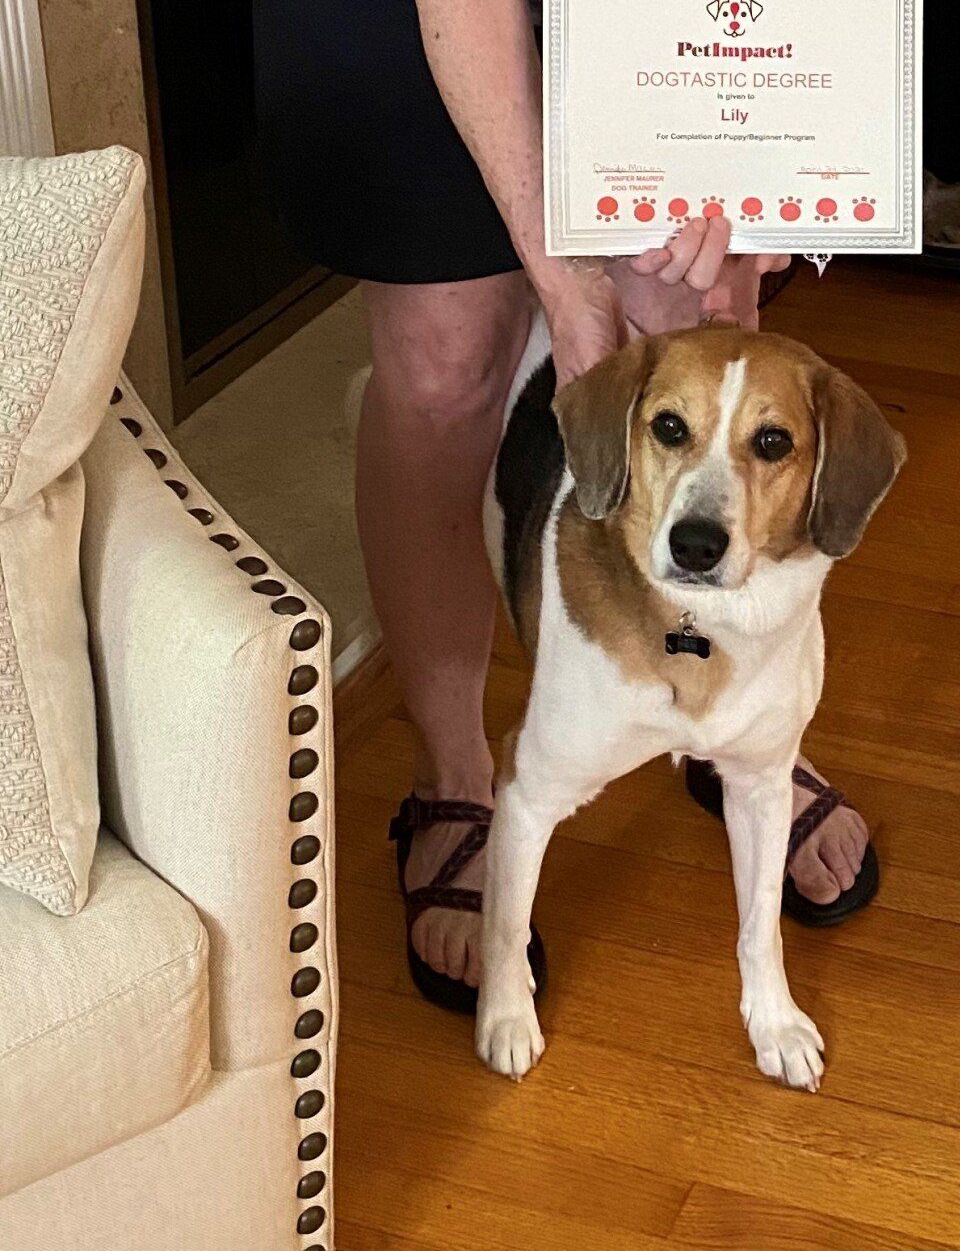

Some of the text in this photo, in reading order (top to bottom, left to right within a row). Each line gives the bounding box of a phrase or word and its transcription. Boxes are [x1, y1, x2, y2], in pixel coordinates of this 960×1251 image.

[676, 41, 793, 62] PetImpact!
[636, 71, 833, 89] DOGTASTIC DEGREE
[725, 93, 746, 101] given
[721, 108, 749, 125] Lily
[670, 132, 713, 141] Completion
[723, 133, 782, 142] Puppy/Beginner
[784, 134, 816, 142] Program
